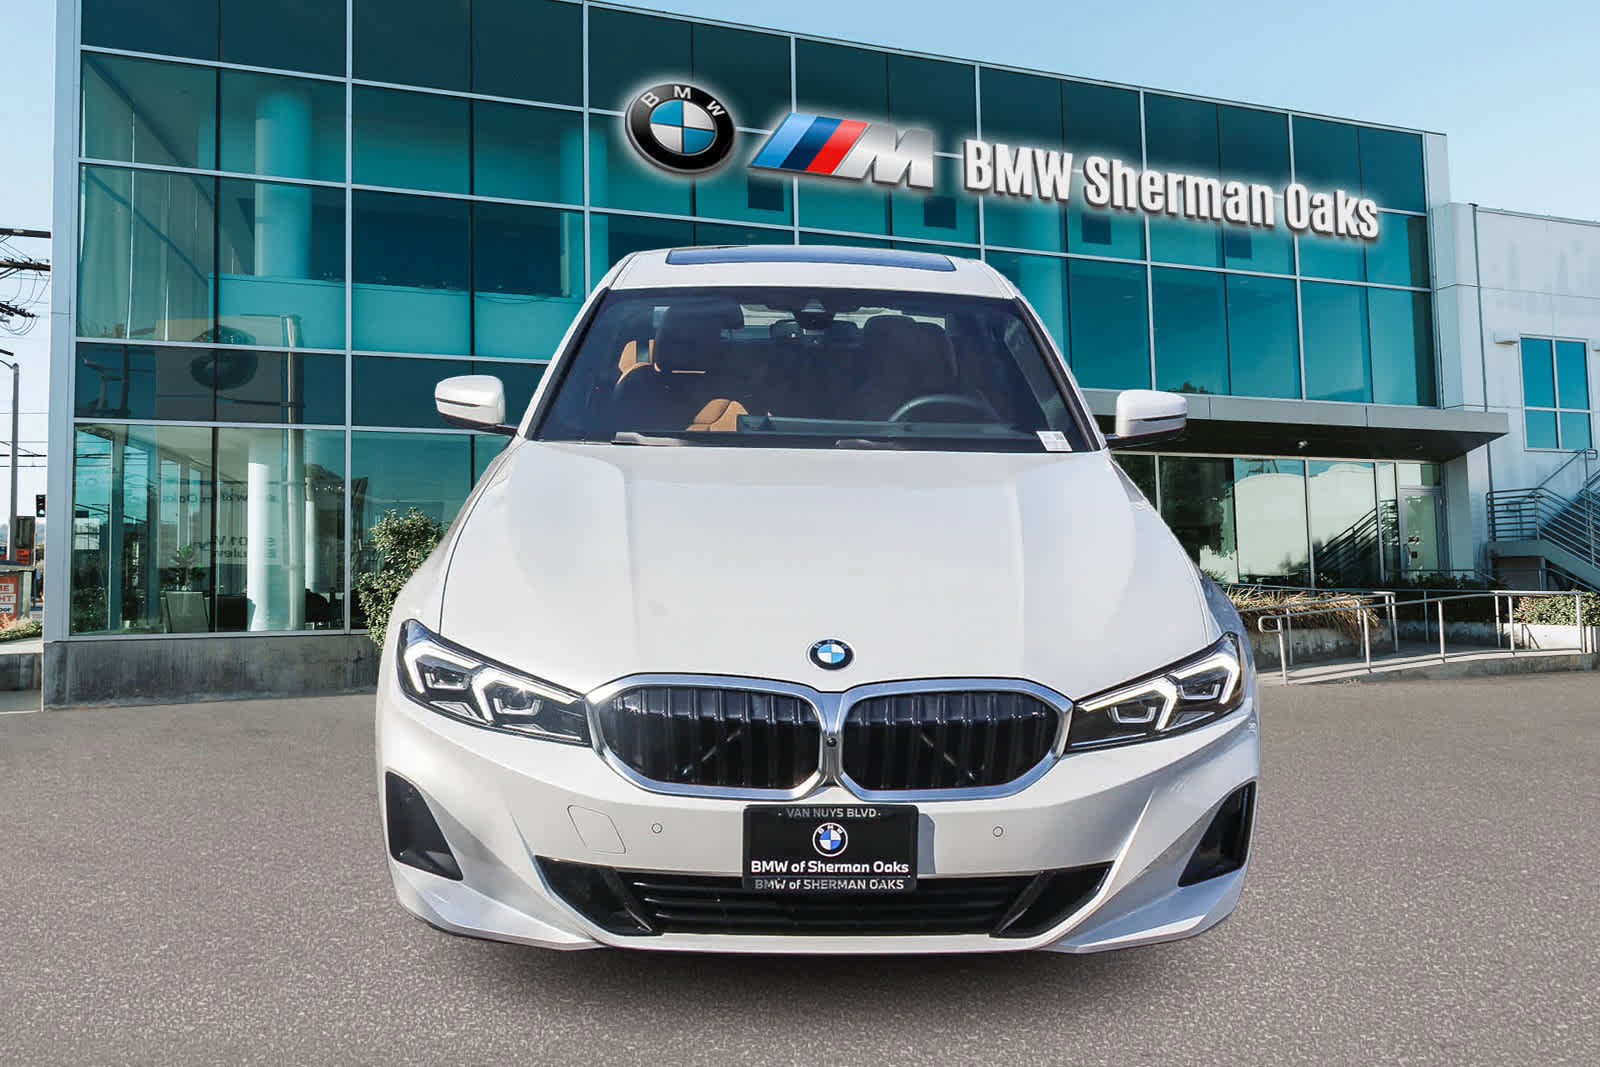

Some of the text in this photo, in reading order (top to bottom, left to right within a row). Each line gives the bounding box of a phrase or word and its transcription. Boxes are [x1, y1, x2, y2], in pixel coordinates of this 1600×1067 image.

[641, 85, 725, 117] BMW
[964, 138, 1380, 240] BMW Sherman Oaks
[786, 808, 877, 818] VAN NUYS BLVD
[751, 860, 909, 873] BMW of Sherman Oaks
[755, 879, 904, 890] BMW of SHERMAN OAKS
